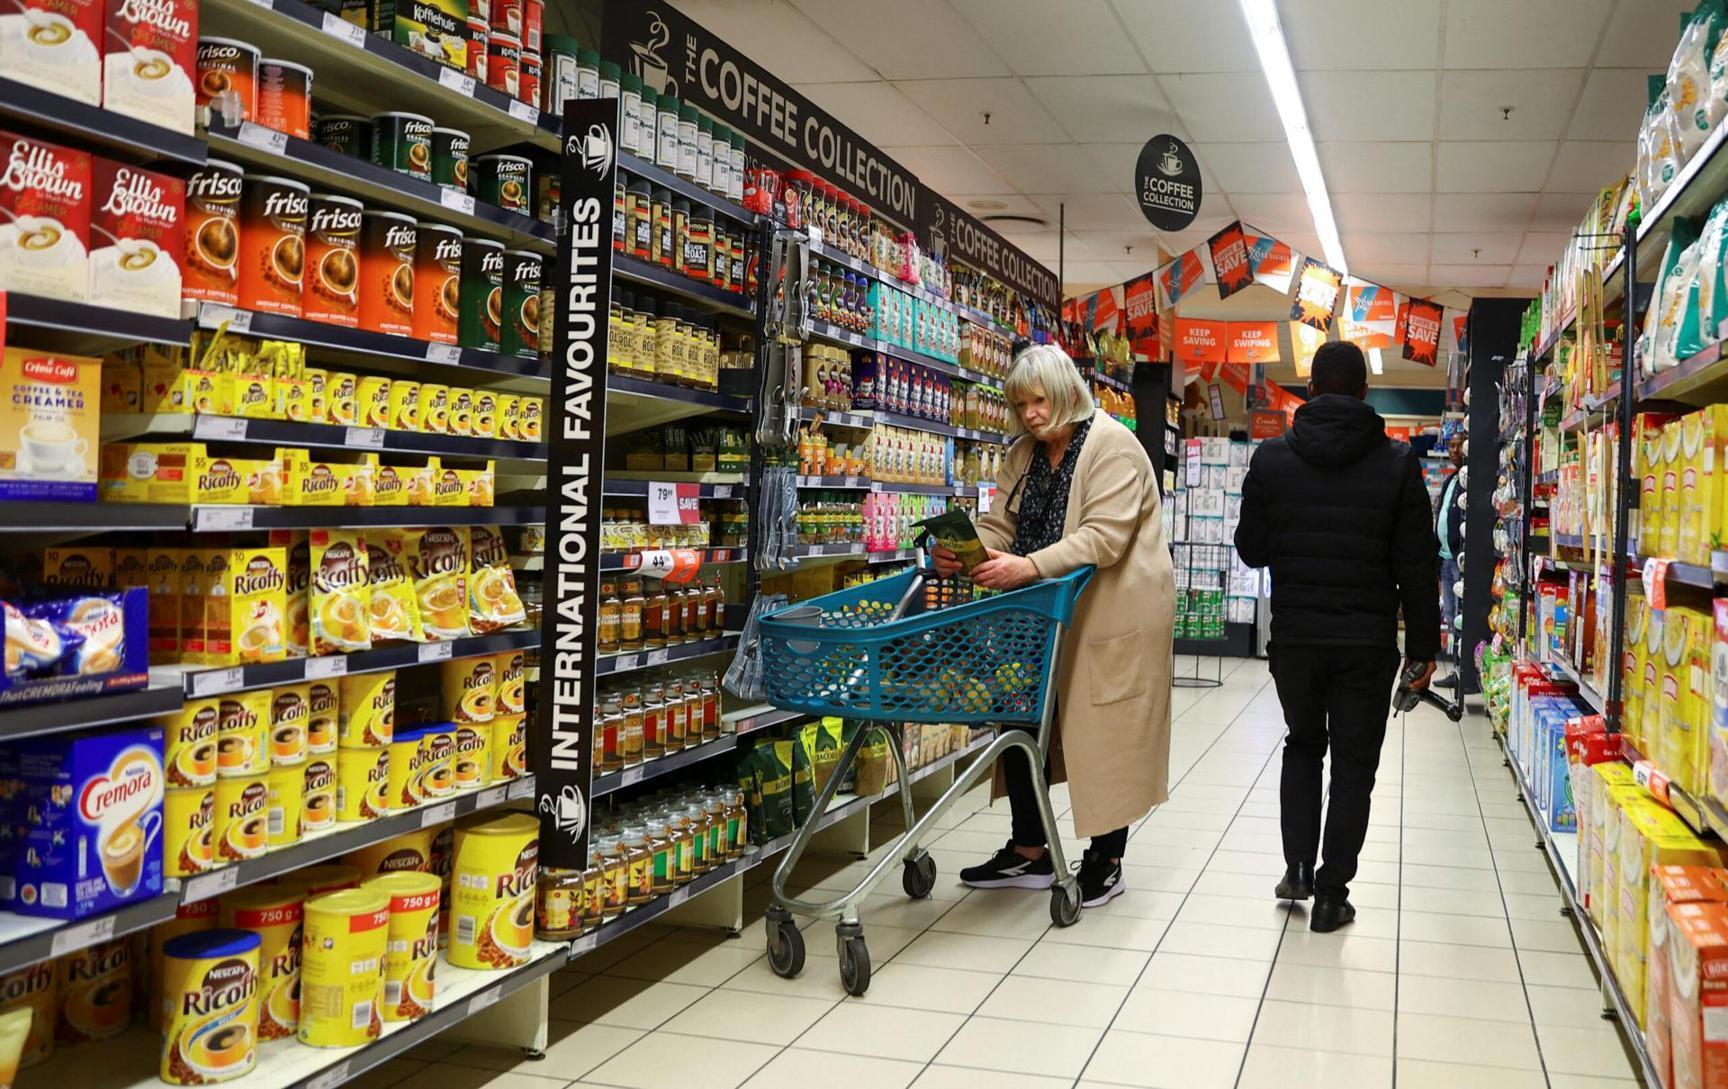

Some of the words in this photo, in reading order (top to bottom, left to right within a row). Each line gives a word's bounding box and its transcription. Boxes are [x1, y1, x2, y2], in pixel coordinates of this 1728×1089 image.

[115, 0, 190, 38] Brown
[686, 33, 697, 84] THE
[699, 47, 798, 148] COFFEE
[804, 115, 916, 221] COLLECTION
[8, 140, 65, 178] Ellis
[0, 159, 83, 200] Brown
[113, 168, 161, 205] Ellis
[1149, 177, 1194, 200] COFFEE
[101, 186, 178, 223] Brown
[1143, 191, 1194, 211] COLLECTION
[955, 217, 1000, 273] COFFEE
[1001, 246, 1058, 306] COLLECTION
[1216, 249, 1249, 278] SAVE
[563, 196, 602, 441] FAVOURITES
[1127, 300, 1155, 321] SAVE
[1182, 336, 1217, 347] SAVING
[1190, 327, 1210, 338] KEEP
[1233, 338, 1272, 348] SWIPING
[1241, 330, 1263, 339] KEEP
[1407, 325, 1439, 346] SAVE
[12, 385, 51, 395] COFFEE
[66, 388, 84, 398] TEA
[12, 394, 84, 410] CREAMER
[198, 471, 242, 491] Ricoffy
[302, 477, 339, 493] Ricoffy
[435, 480, 464, 496] Ricoffy
[679, 497, 699, 511] SAVE
[234, 570, 286, 594] Ricoffy
[310, 556, 371, 597] Ricoffy
[550, 451, 589, 770] INTERNATIONAL
[80, 770, 152, 821] Cremora
[402, 896, 423, 908] 750
[261, 911, 283, 924] 750
[208, 965, 245, 980] NESCAFÉ
